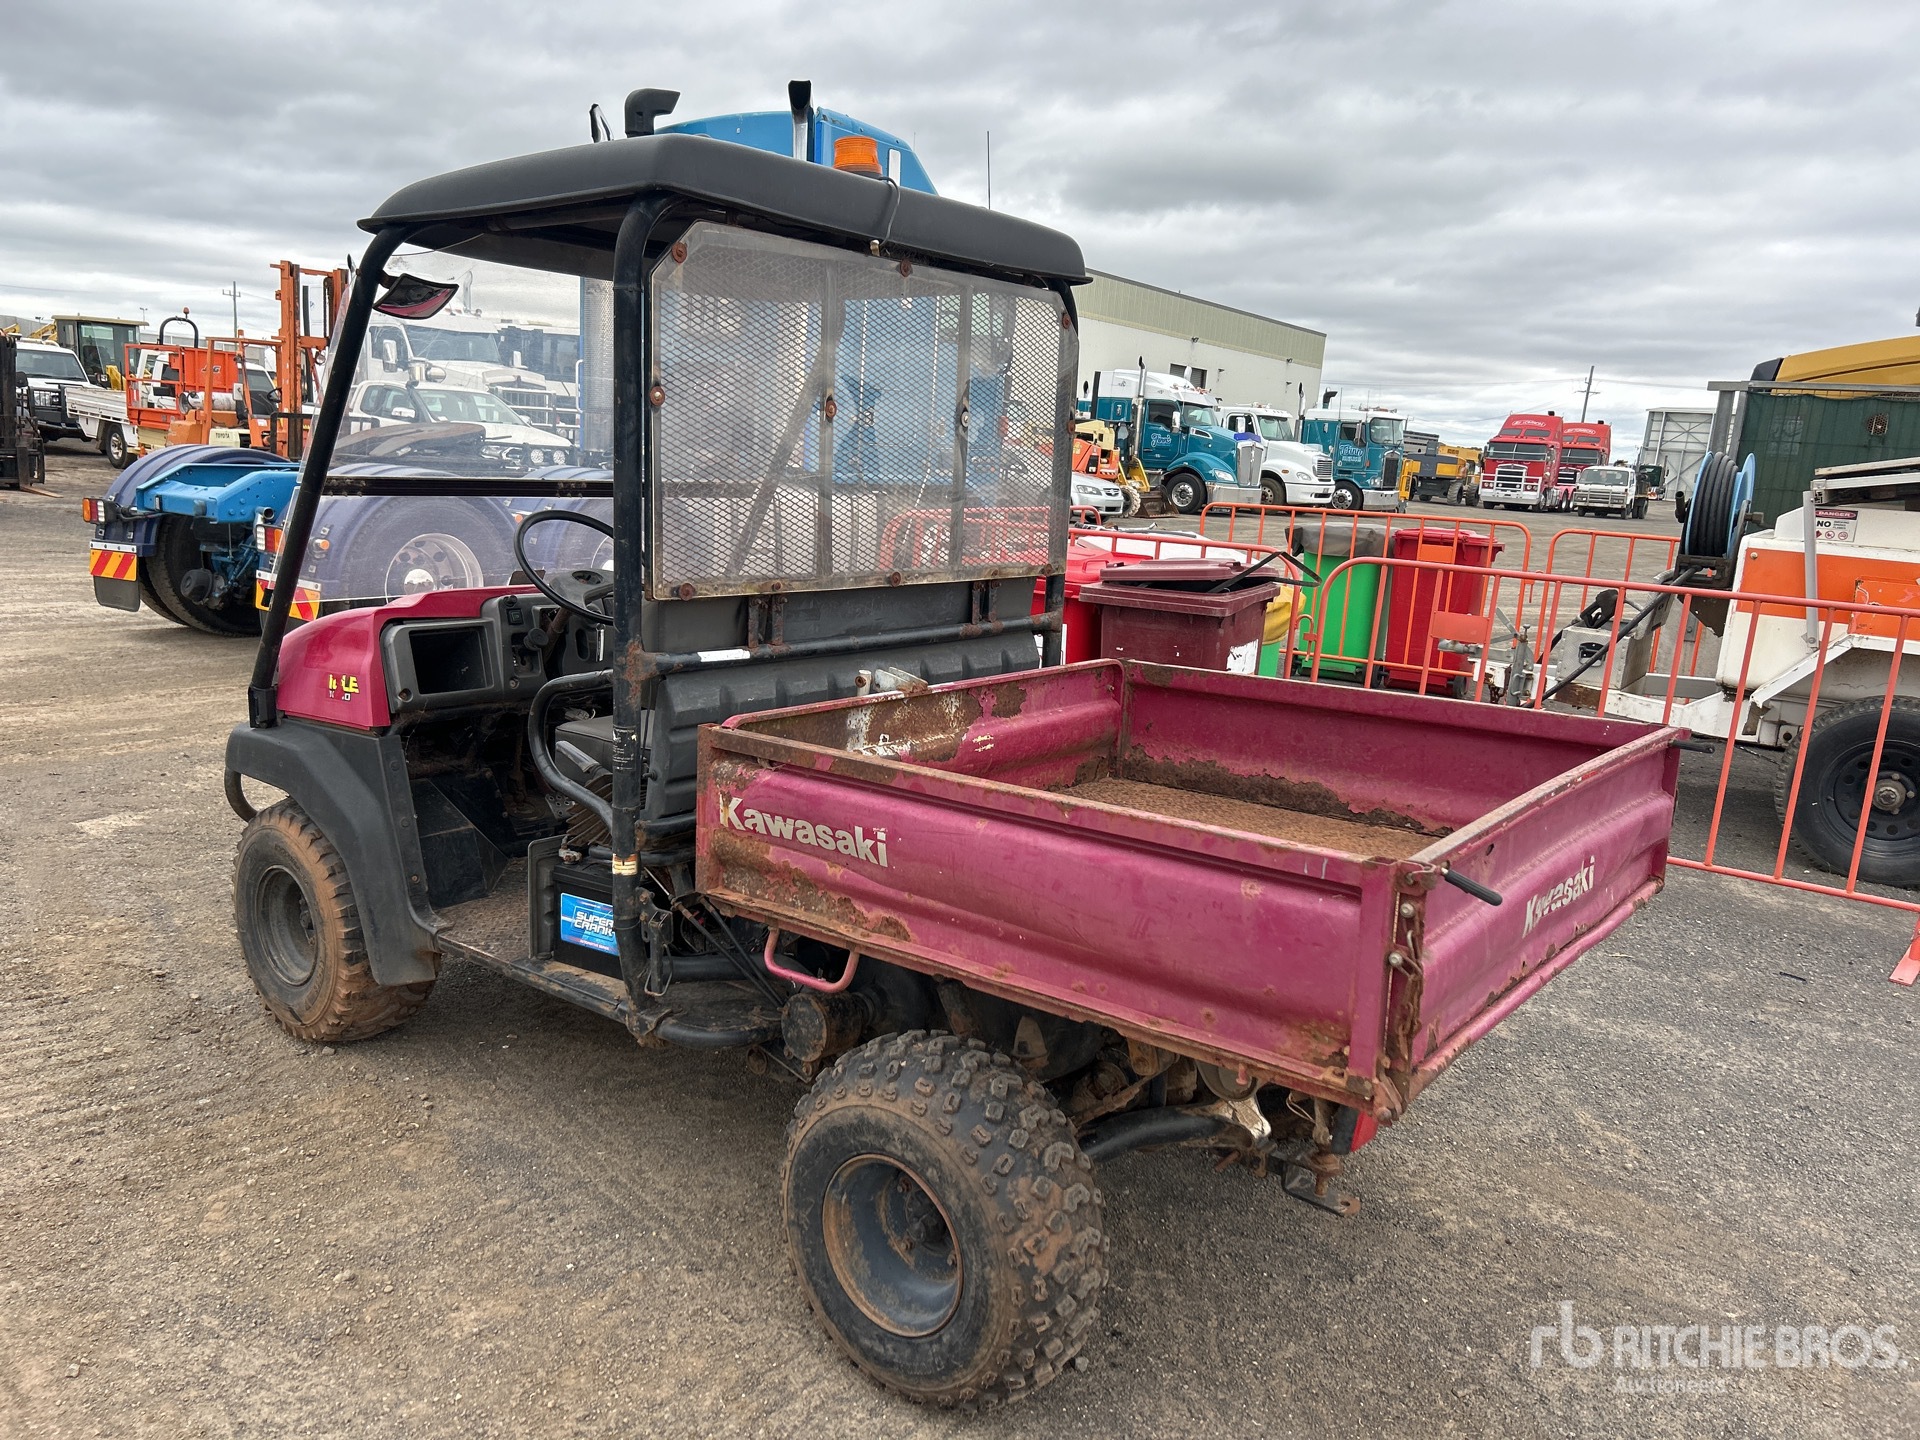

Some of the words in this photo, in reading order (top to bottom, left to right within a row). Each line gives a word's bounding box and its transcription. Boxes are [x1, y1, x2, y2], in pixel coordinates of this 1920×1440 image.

[1816, 520, 1832, 528] NO
[719, 793, 888, 868] Kawasaki
[1522, 855, 1595, 939] Kawasaki
[574, 919, 615, 937] CRANK
[575, 910, 614, 928] SUPER
